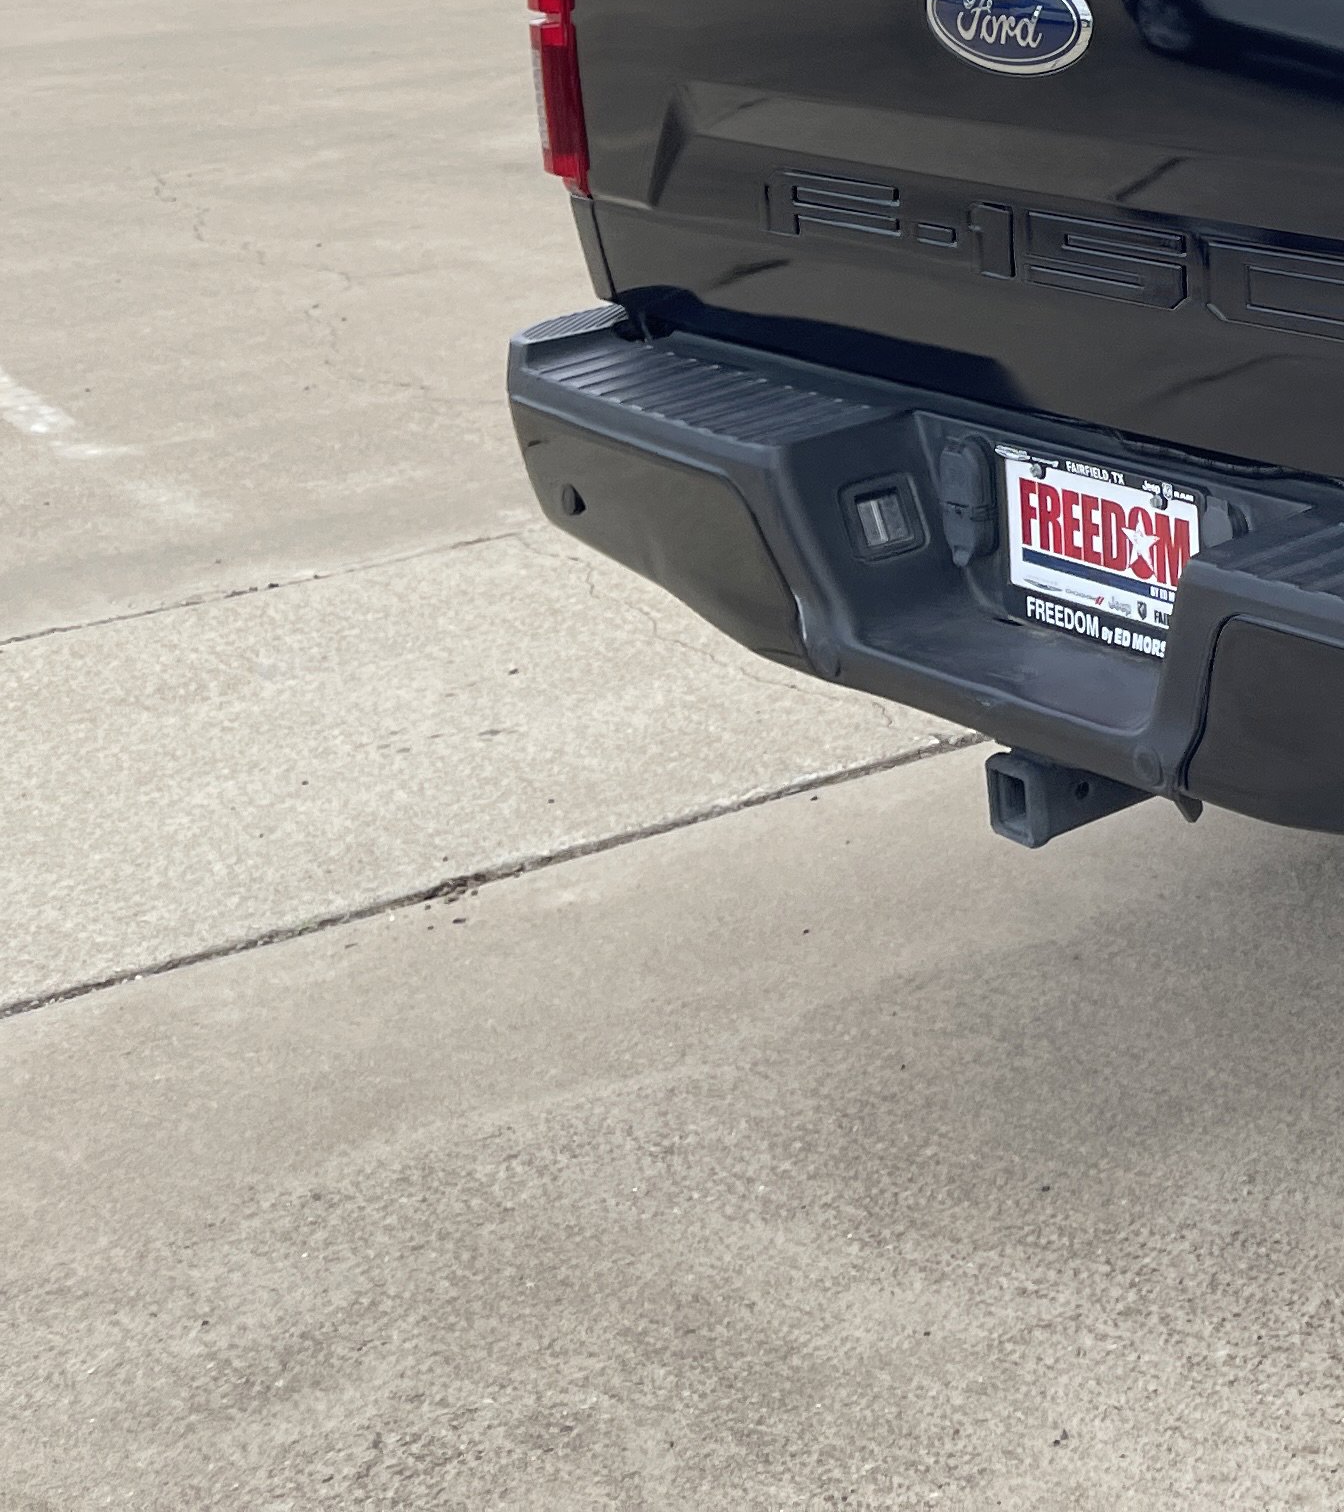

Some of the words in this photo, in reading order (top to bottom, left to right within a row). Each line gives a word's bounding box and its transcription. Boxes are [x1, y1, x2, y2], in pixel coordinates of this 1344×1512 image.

[1065, 460, 1112, 484] FAIRFIELD,
[1111, 471, 1125, 486] TX
[1018, 476, 1191, 587] FREEDOM
[1026, 595, 1100, 639] FREEDOM
[1114, 627, 1131, 648] ED
[1108, 595, 1132, 616] Jeep
